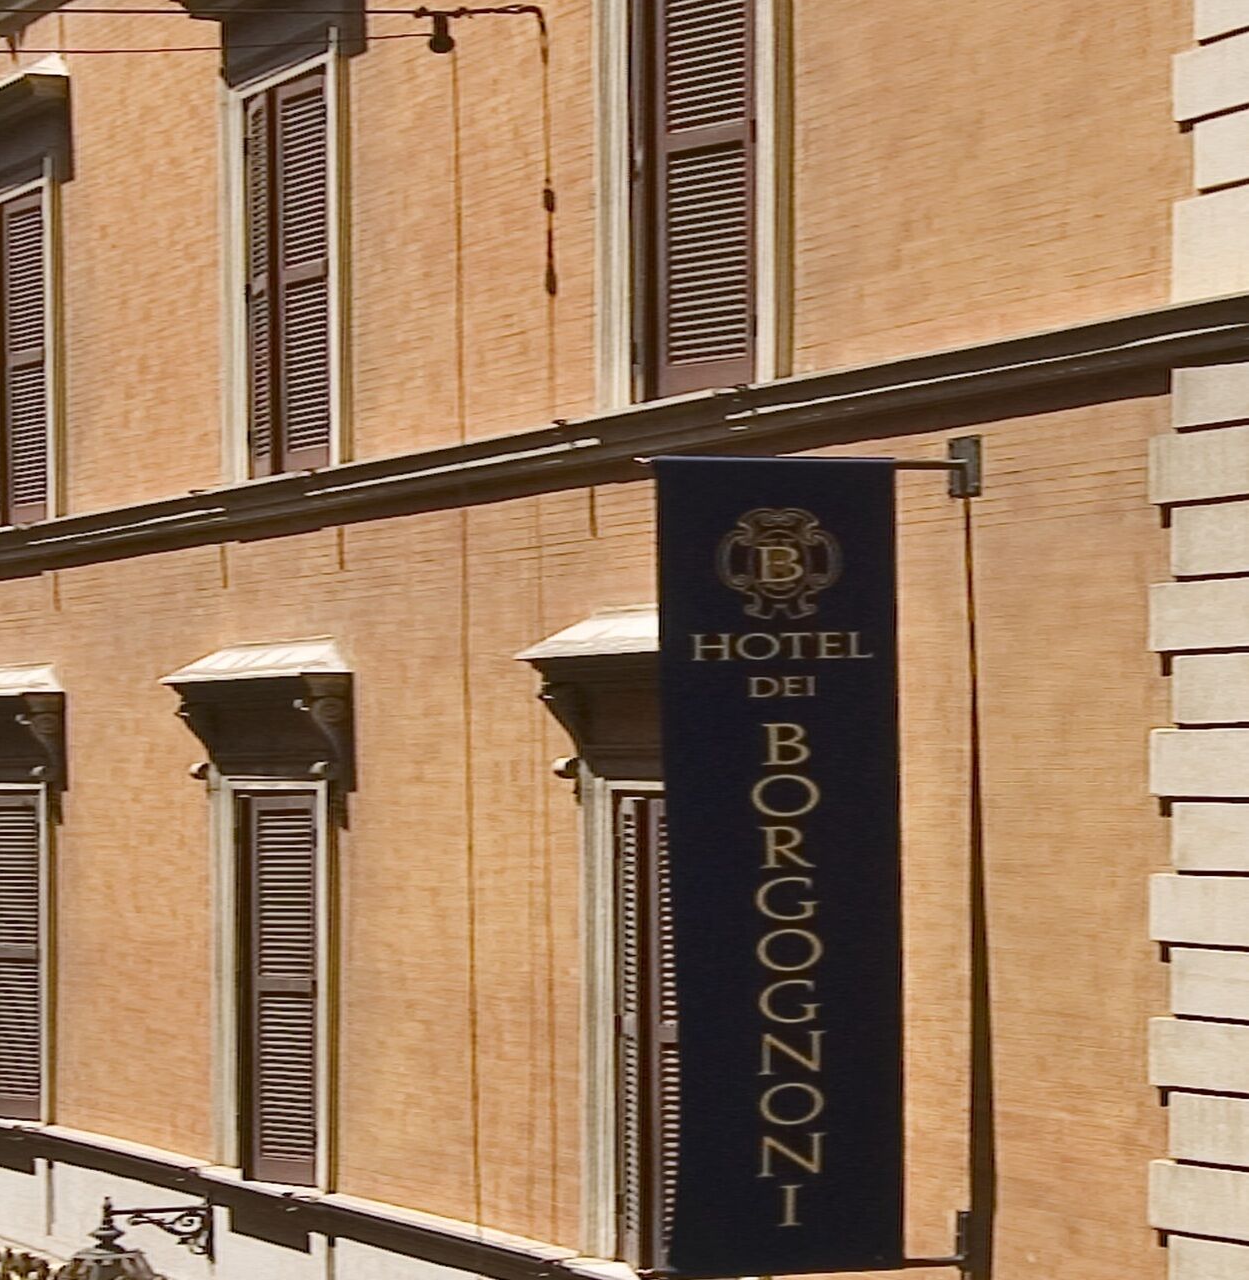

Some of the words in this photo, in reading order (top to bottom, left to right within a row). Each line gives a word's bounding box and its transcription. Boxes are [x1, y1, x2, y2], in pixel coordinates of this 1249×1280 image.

[754, 546, 804, 582] B
[689, 630, 875, 663] HOTEL
[748, 675, 816, 698] DEI
[750, 722, 828, 1228] BORGOGNONI
